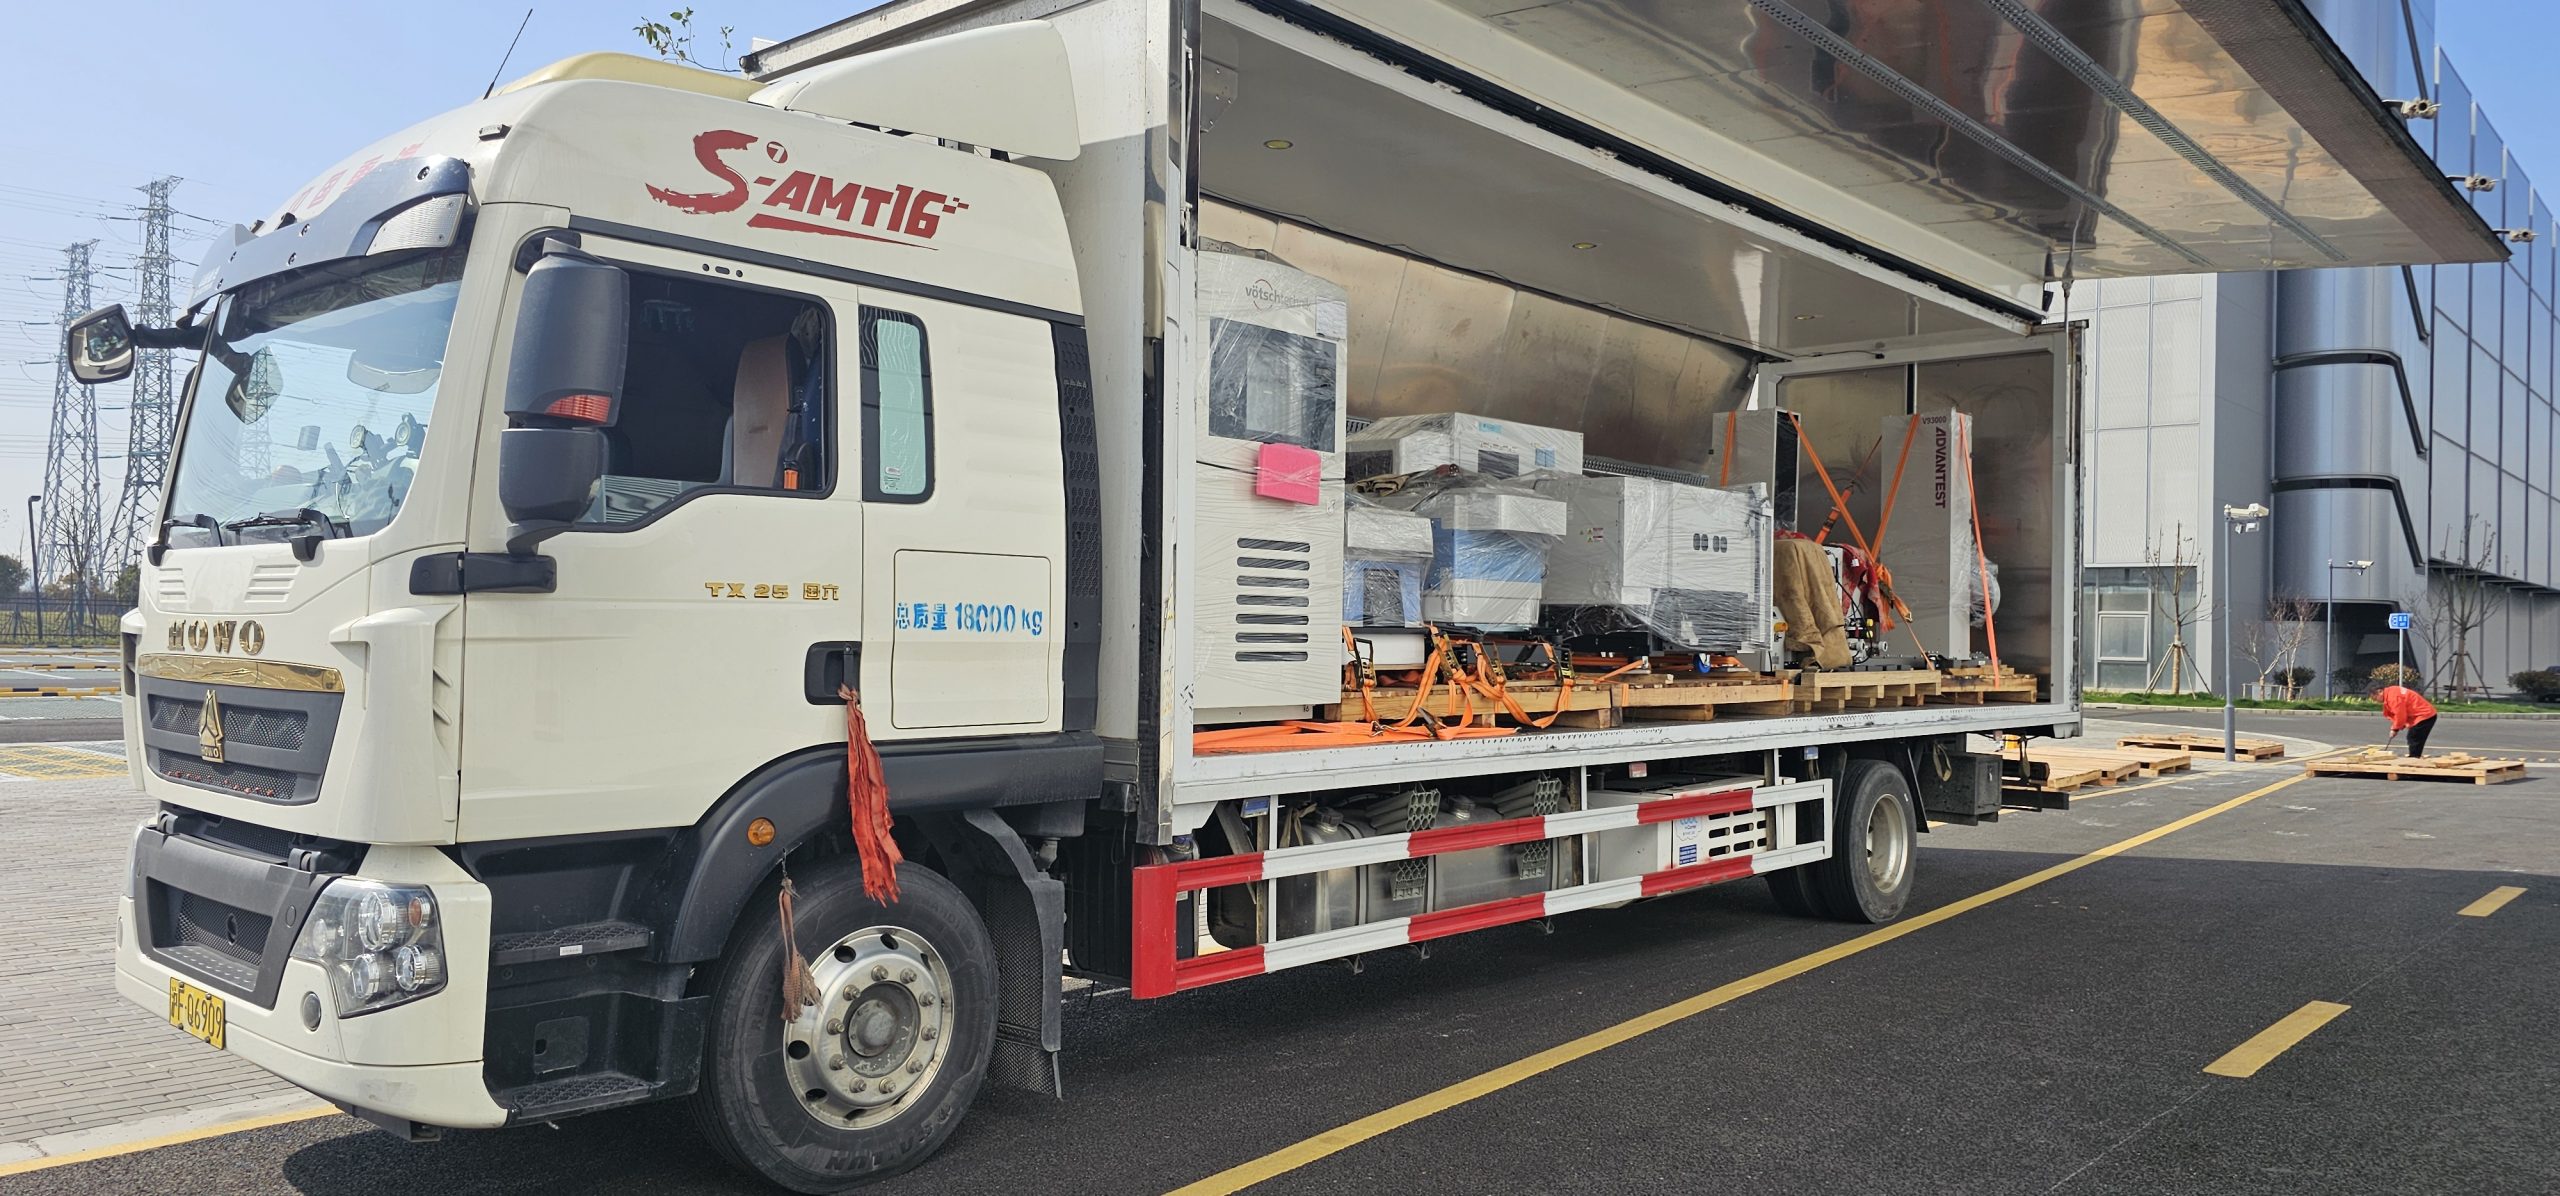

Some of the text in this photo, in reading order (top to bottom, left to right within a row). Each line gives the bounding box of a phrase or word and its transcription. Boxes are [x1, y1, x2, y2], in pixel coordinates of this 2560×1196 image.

[1922, 415, 1947, 425] V93000
[1935, 426, 1947, 509] ADVANTEST
[705, 582, 747, 599] TX
[754, 583, 788, 599] 25
[896, 602, 1043, 635] 总质量 18000 kg
[167, 619, 265, 655] HOWO
